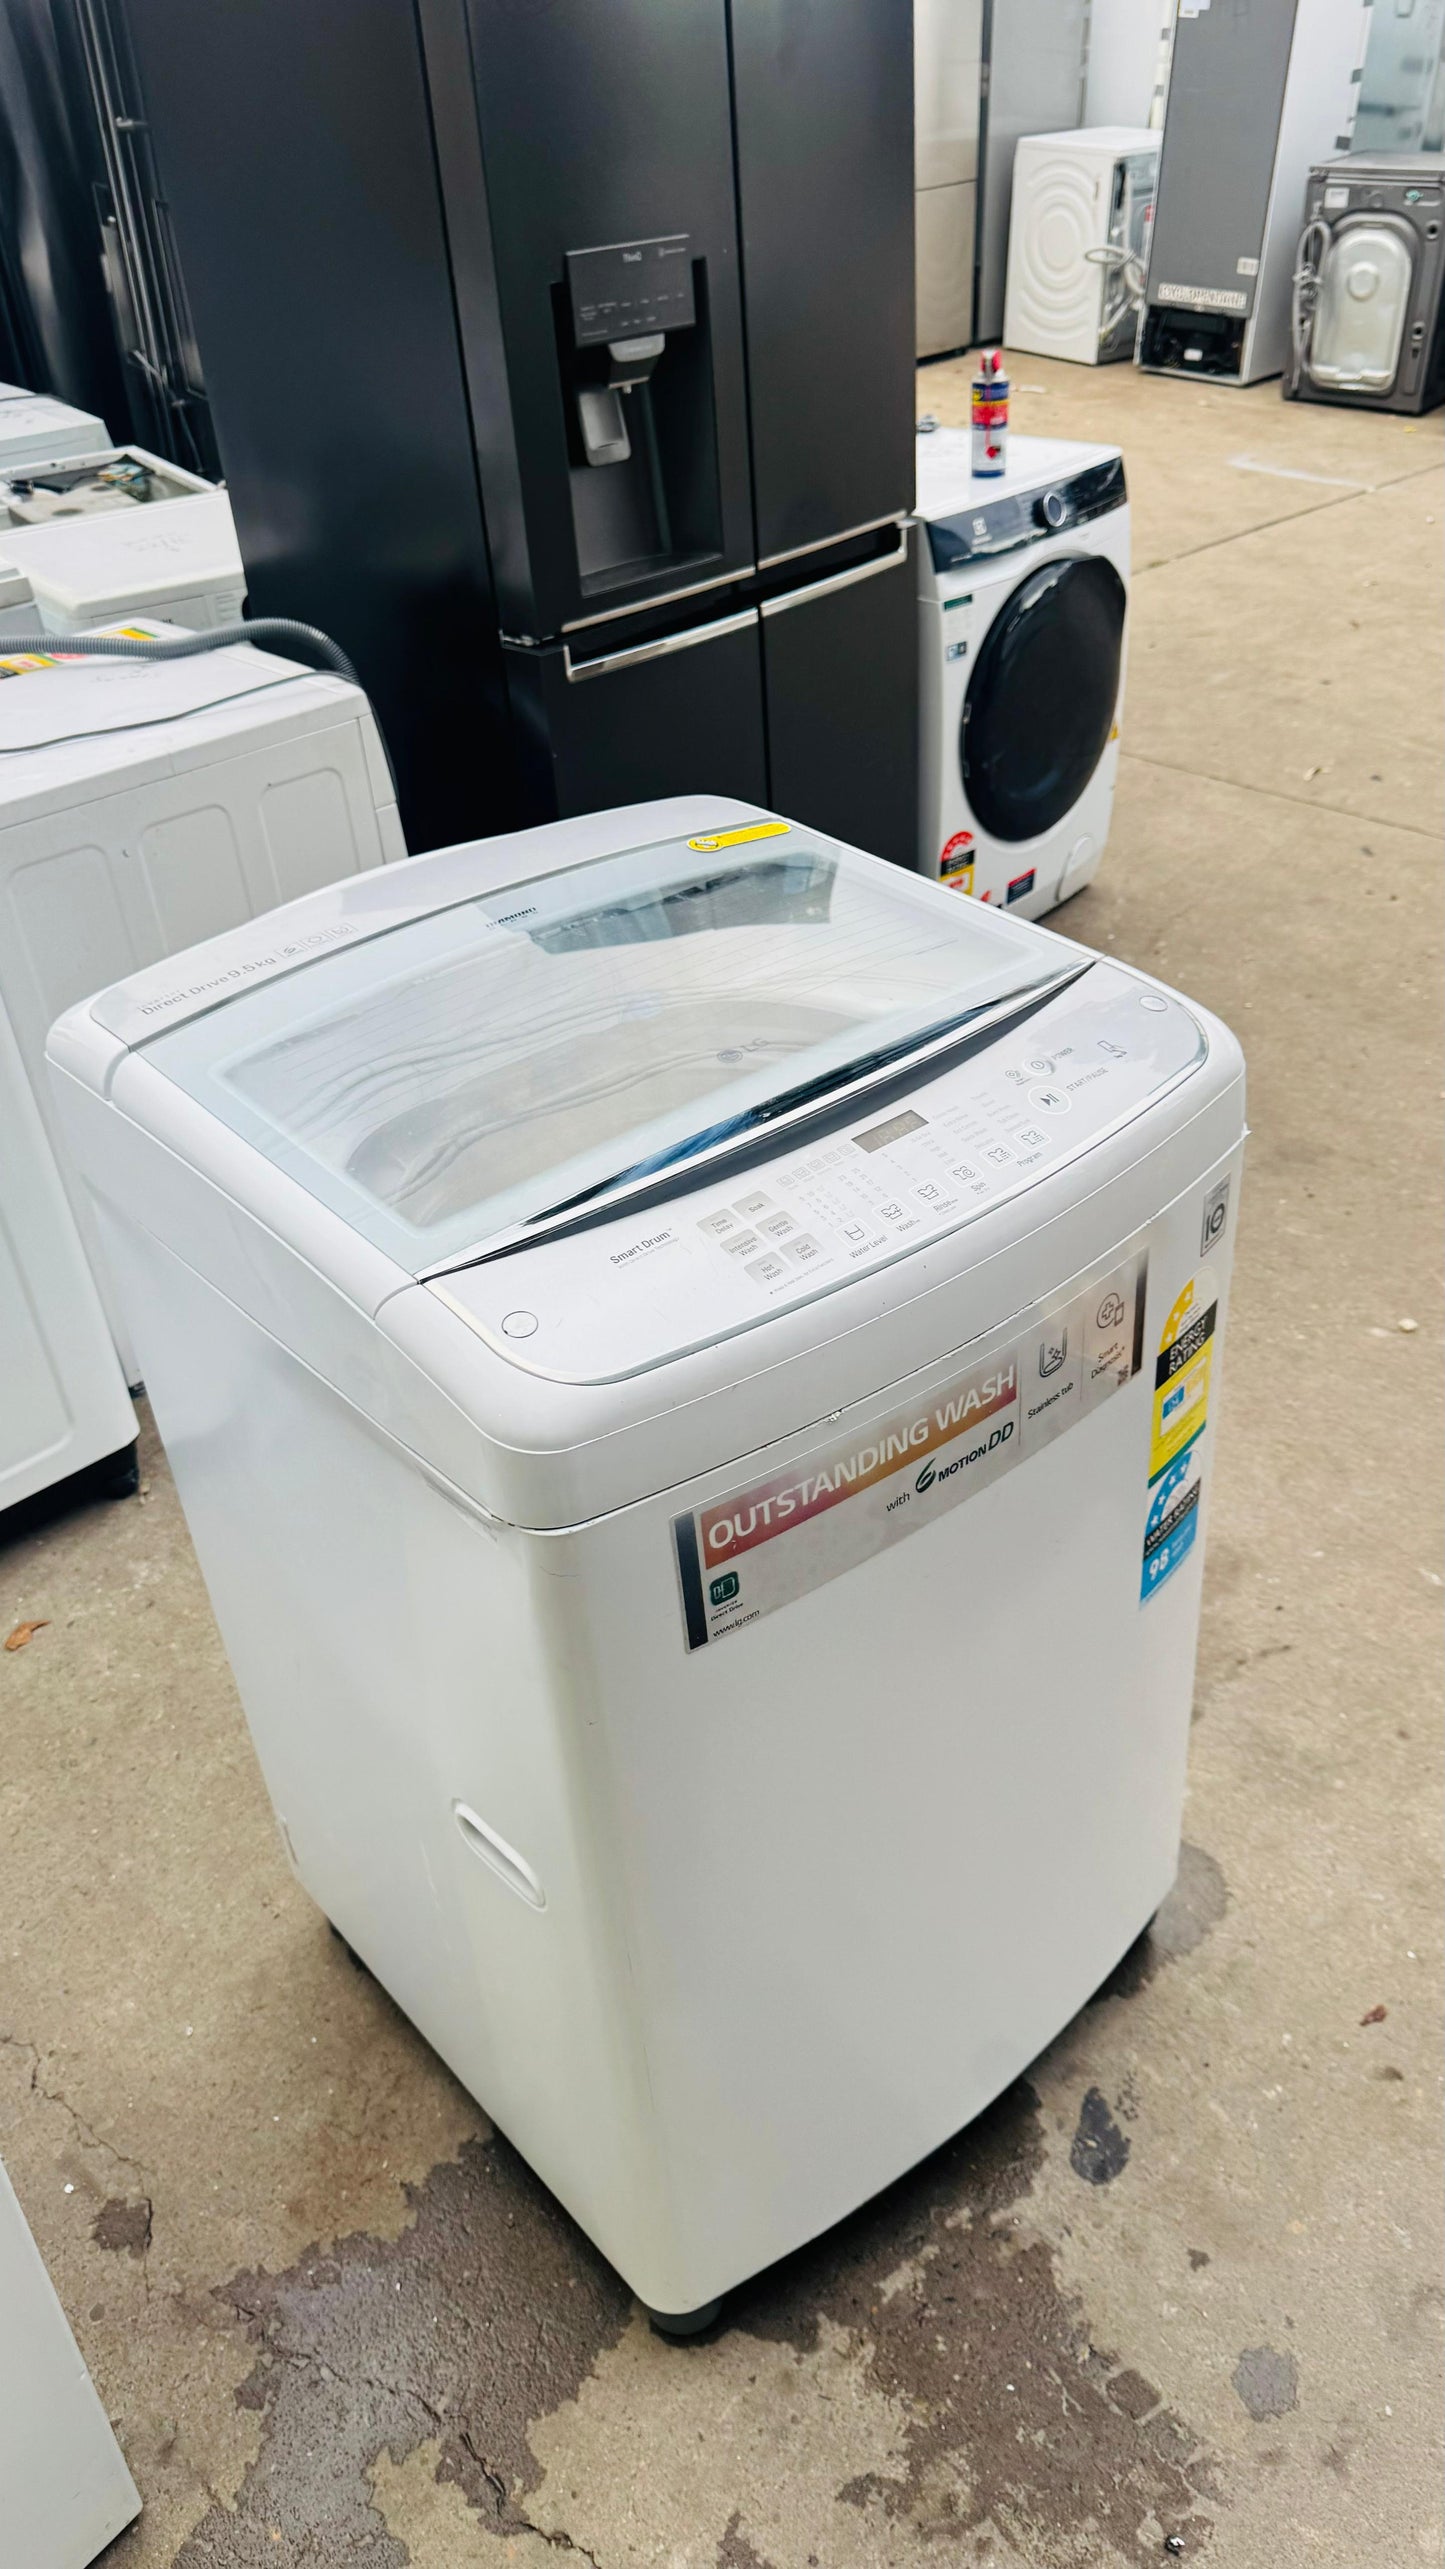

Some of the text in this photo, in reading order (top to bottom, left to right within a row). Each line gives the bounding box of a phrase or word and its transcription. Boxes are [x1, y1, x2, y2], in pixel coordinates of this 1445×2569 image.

[139, 992, 190, 1016] Direct
[189, 975, 229, 996] Drive
[1017, 1151, 1043, 1168] Program
[748, 1202, 765, 1213] Soak
[715, 1223, 735, 1235] Delay
[775, 1225, 794, 1237] Wash
[895, 1219, 917, 1232] Wash
[609, 1245, 643, 1264] Smart
[738, 1244, 759, 1256] Wash
[795, 1243, 811, 1255] Cold
[800, 1248, 819, 1261] Wash
[849, 1234, 889, 1259] Water Level
[760, 1263, 775, 1273] Hot
[763, 1268, 784, 1281] Wash
[1169, 1315, 1208, 1362] ENERGY
[1168, 1331, 1206, 1377] RATING
[1027, 1382, 1074, 1420] Stainless tub
[708, 1364, 1015, 1550] OUTSTANDING WASH
[886, 1492, 911, 1513] with
[712, 1609, 761, 1638] www.lg.com
